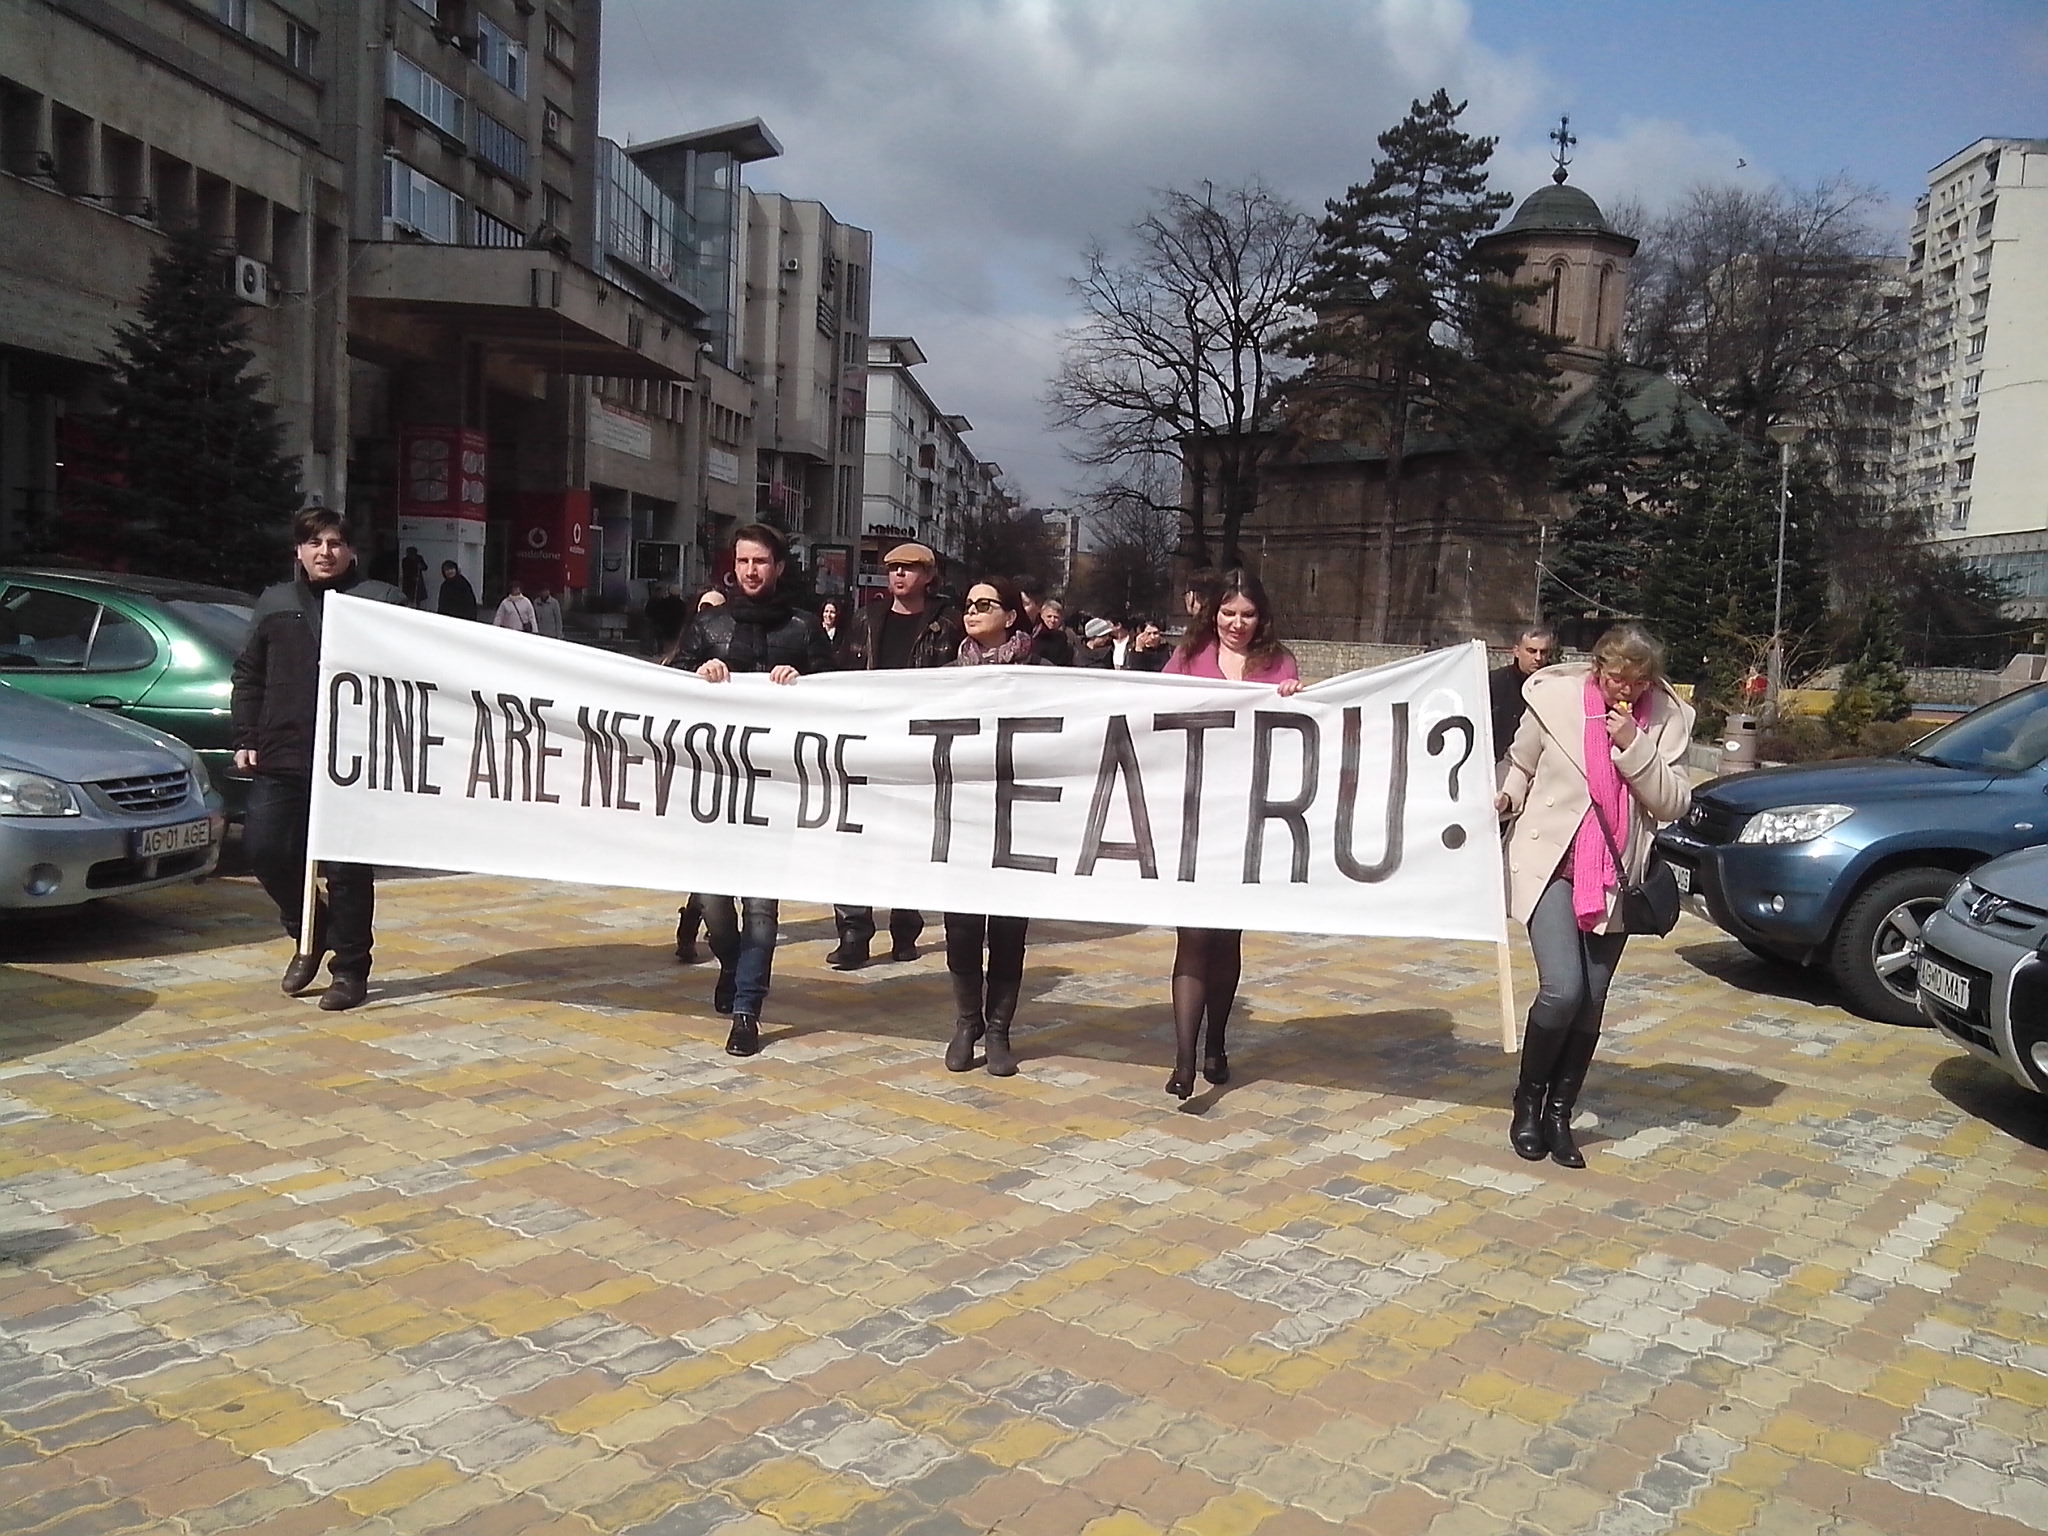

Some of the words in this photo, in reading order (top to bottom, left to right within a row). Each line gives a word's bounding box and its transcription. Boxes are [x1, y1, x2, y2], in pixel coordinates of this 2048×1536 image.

[328, 672, 445, 795] CINE
[466, 689, 563, 804] ARE
[577, 705, 772, 827] NEVOIE
[793, 730, 869, 834] DE
[144, 831, 161, 853] AG
[166, 828, 178, 849] 01
[183, 822, 208, 847] AGE
[1945, 973, 1968, 1004] MAT
